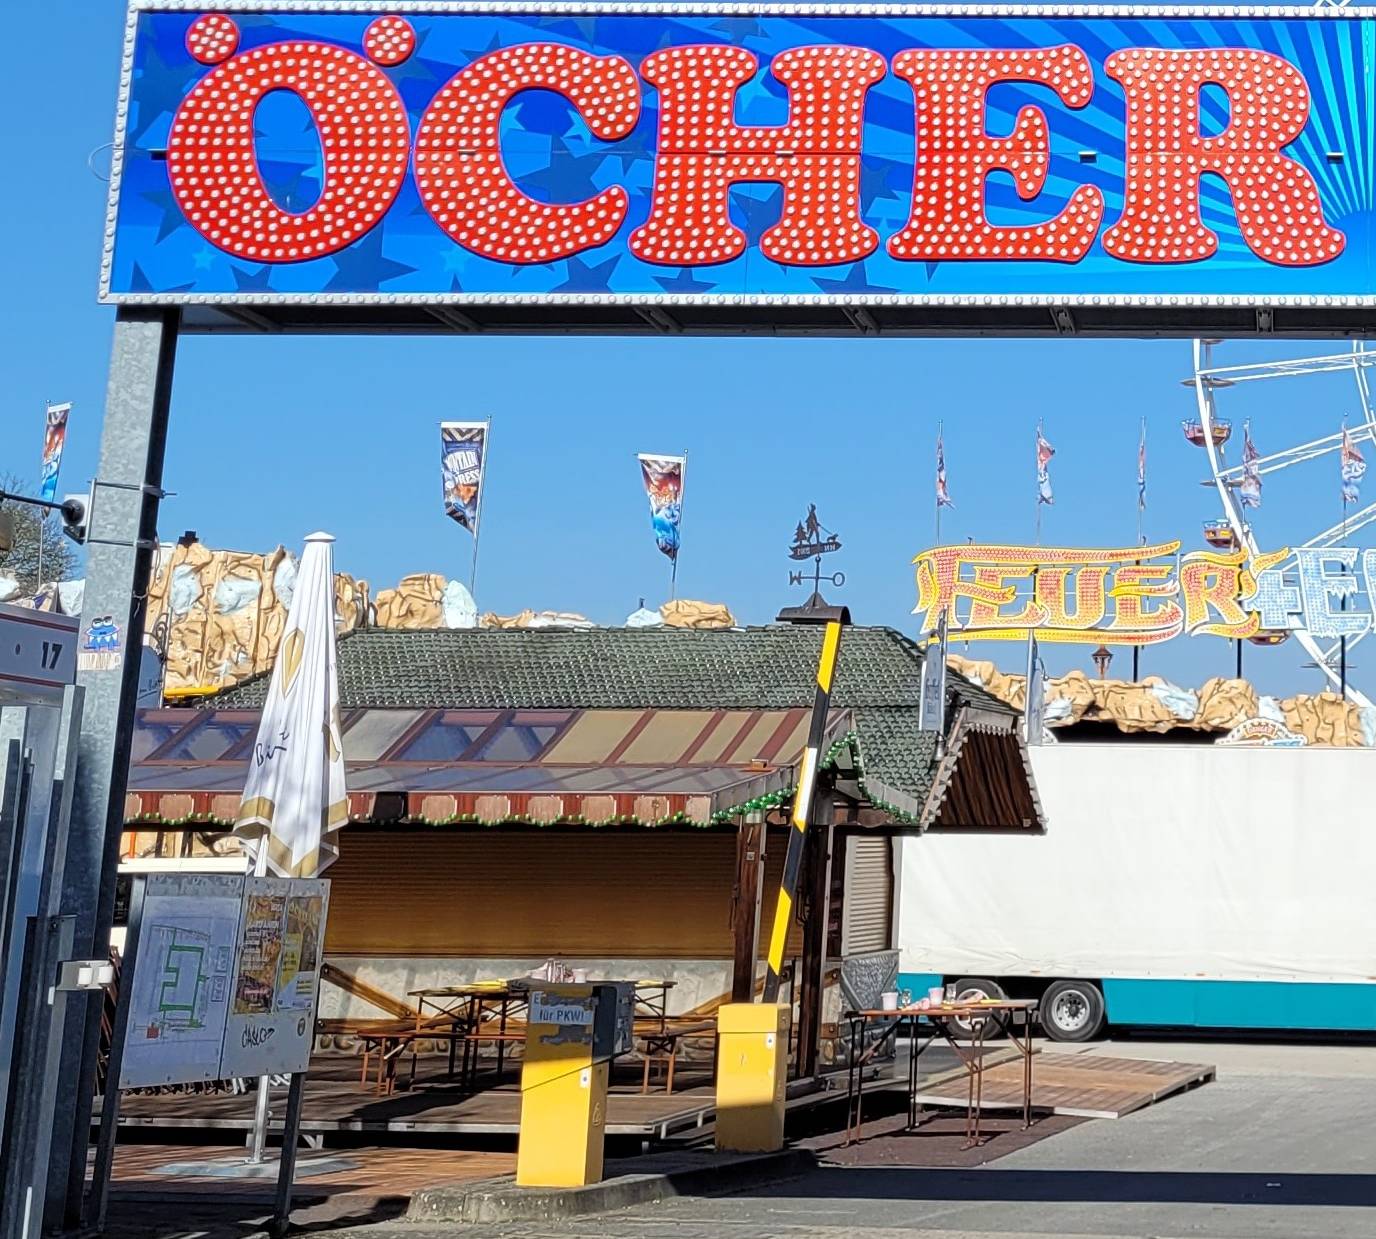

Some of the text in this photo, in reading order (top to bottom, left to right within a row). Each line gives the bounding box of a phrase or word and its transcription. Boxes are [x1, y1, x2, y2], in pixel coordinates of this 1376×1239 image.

[165, 14, 1346, 269] ÖCHER
[912, 540, 1262, 647] FEUER
[41, 641, 63, 670] 17
